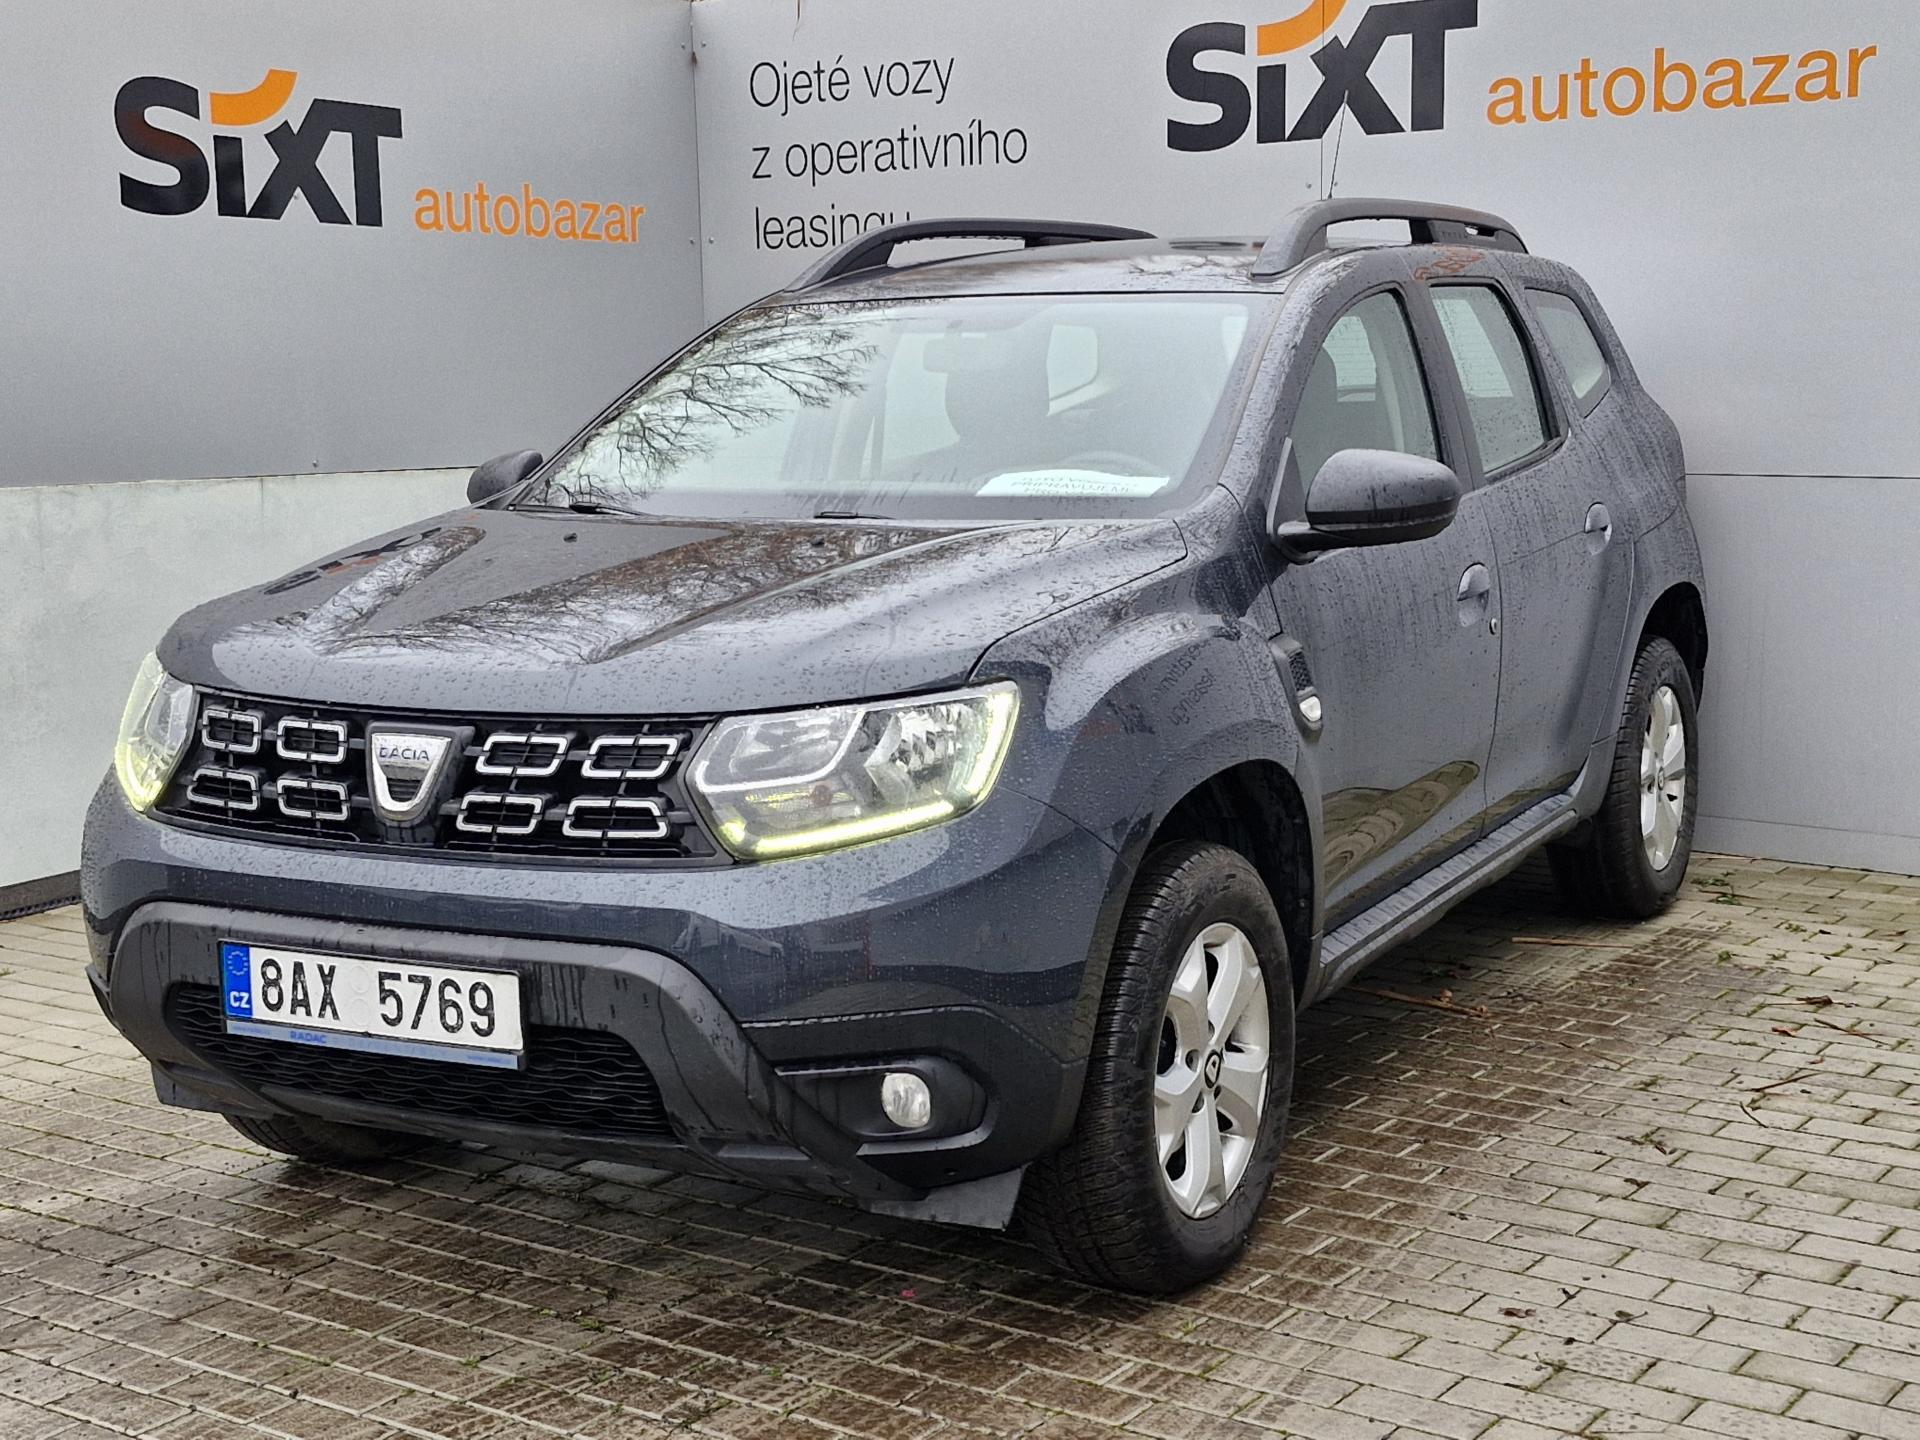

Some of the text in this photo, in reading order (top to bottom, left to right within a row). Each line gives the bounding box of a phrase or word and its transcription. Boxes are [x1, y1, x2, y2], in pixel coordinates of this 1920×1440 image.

[750, 55, 954, 117] Ojeté vozy
[1486, 44, 1878, 126] autobazar
[752, 118, 1028, 187] z operativního
[414, 181, 646, 243] autobazar
[755, 203, 910, 250] leasin
[379, 746, 430, 761] DACIA
[229, 990, 250, 1008] CZ
[260, 958, 496, 1037] 8AX 5769
[290, 1030, 328, 1044] RADAC
